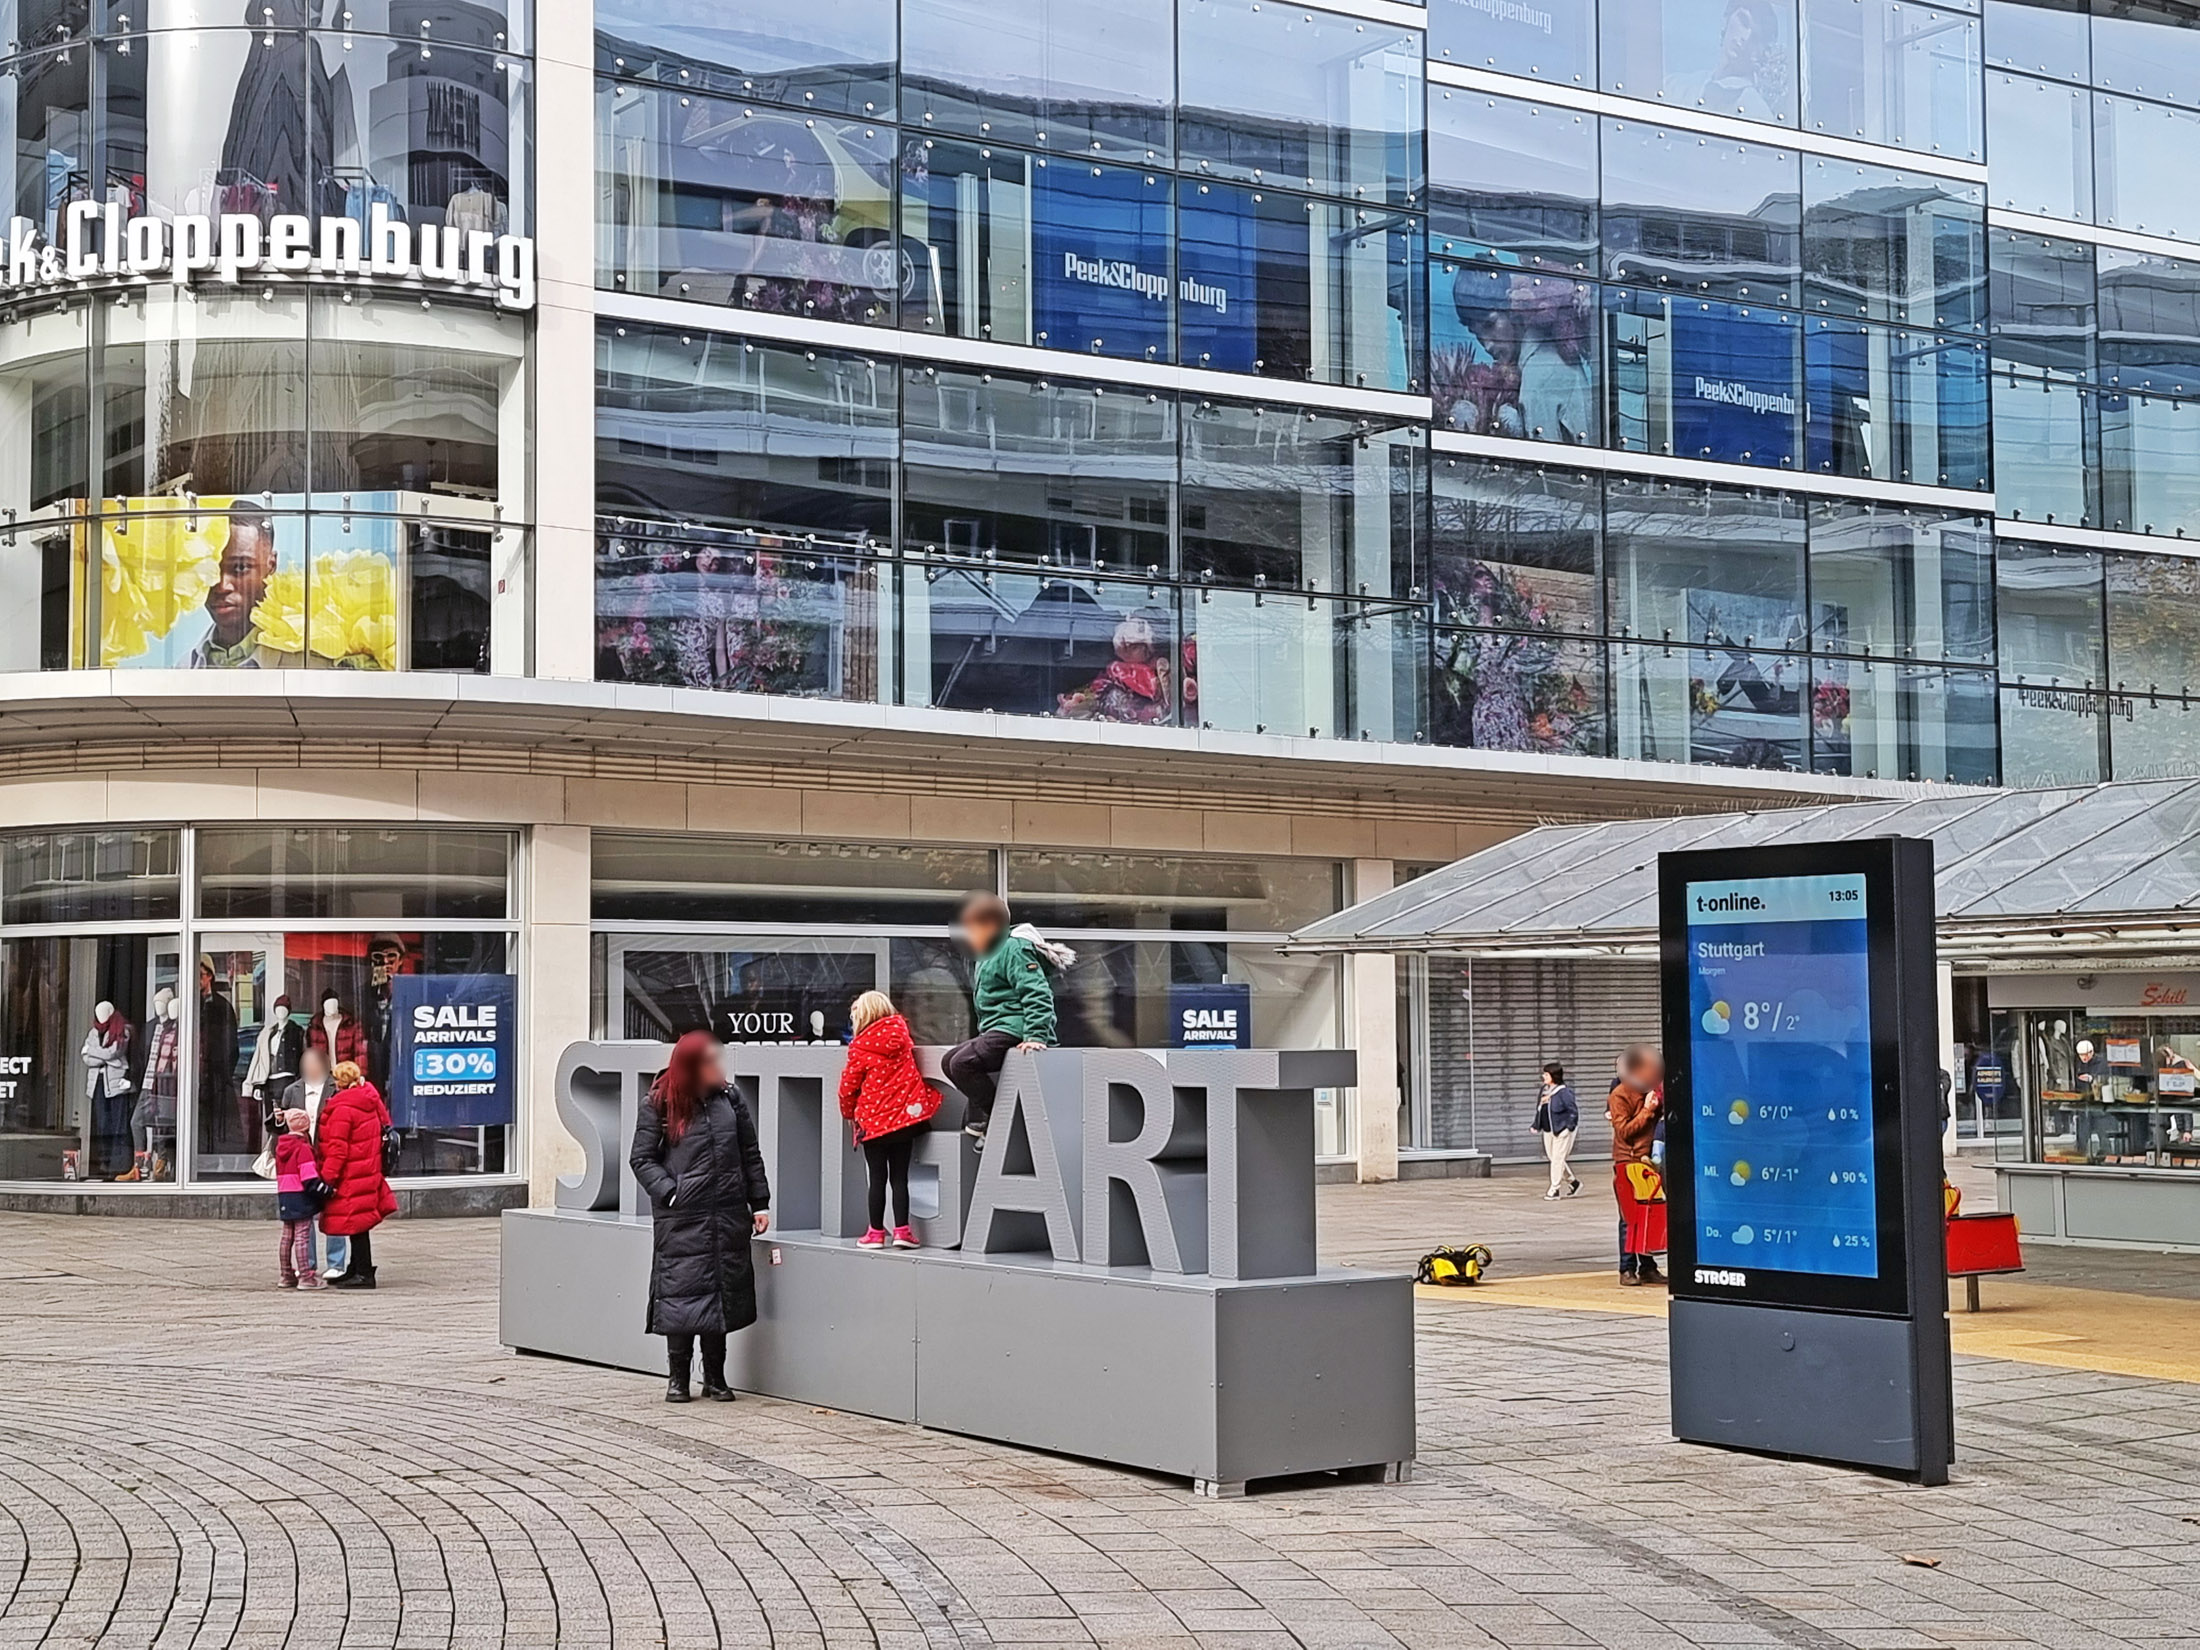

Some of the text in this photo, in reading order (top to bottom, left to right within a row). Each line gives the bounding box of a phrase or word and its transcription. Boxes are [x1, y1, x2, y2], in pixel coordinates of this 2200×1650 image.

[0, 198, 535, 310] k&Cloppenburg
[1064, 251, 1227, 314] Peek&Cloppnburg
[1695, 376, 1811, 423] Peek&Cloppenb
[2021, 688, 2134, 722] Peek&Cloppurg
[1828, 889, 1859, 902] 13:05
[1698, 941, 1765, 961] Stuttgart
[1698, 966, 1726, 977] Morgen
[413, 1005, 497, 1029] SALE
[727, 1012, 795, 1034] YOUR
[1182, 1009, 1237, 1028] SALE
[414, 1030, 496, 1043] ARRIVALS
[1183, 1030, 1237, 1040] ARRIVALS
[425, 1053, 494, 1075] 30%
[413, 1083, 496, 1096] REDUZIERT
[1702, 1105, 1715, 1117] Di.
[1704, 1166, 1719, 1177] Mi.
[1706, 1226, 1722, 1238] Do.
[1694, 1269, 1747, 1287] STRÖER
